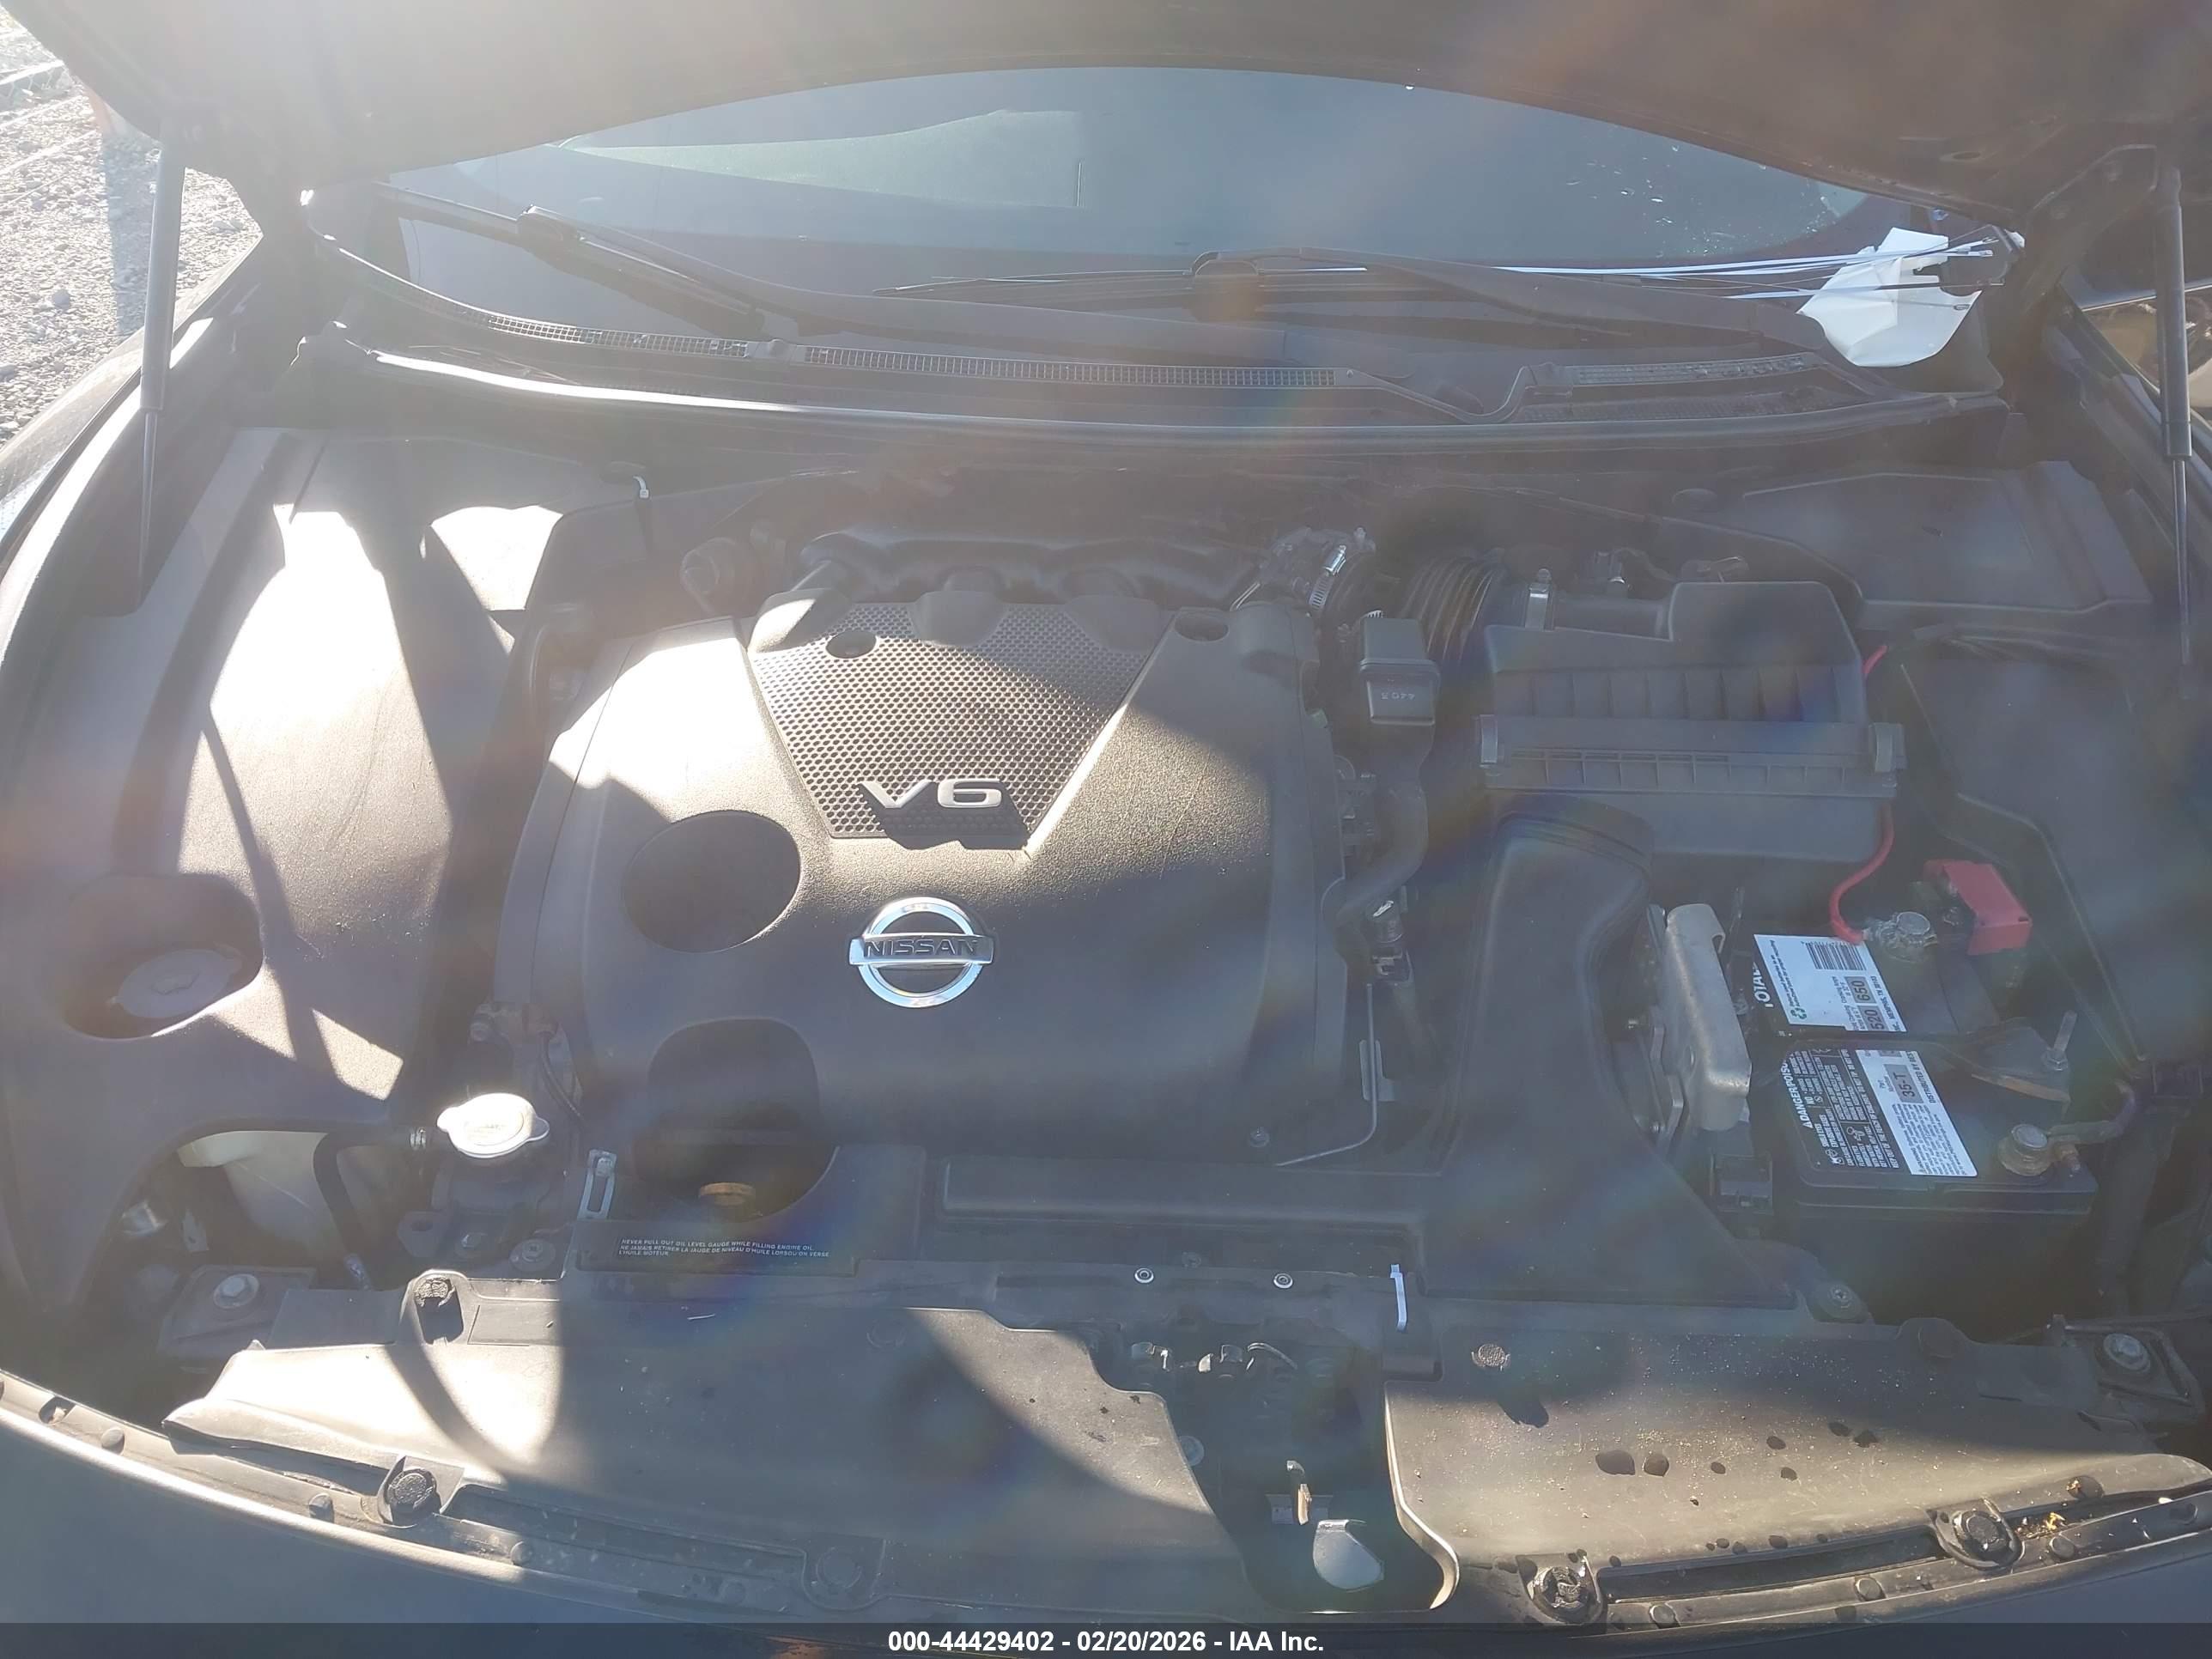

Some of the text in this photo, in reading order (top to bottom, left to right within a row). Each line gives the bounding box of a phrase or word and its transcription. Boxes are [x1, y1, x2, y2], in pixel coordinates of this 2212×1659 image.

[860, 778, 1002, 808] V6
[866, 938, 979, 958] NISSAN
[1851, 981, 1870, 1001] 650
[1864, 1009, 1884, 1029] 520
[1893, 1072, 1914, 1097] 35-T
[1916, 1071, 1936, 1103] DISTRIBUTED
